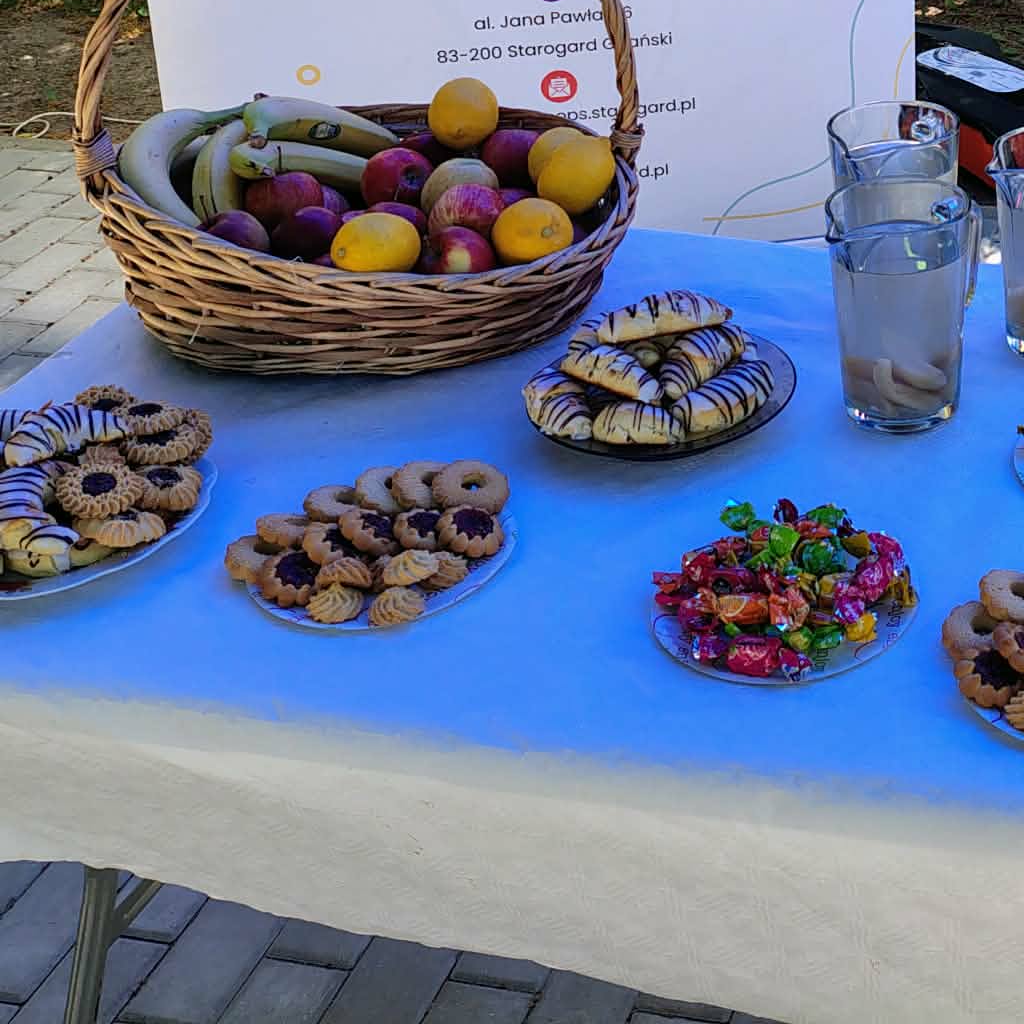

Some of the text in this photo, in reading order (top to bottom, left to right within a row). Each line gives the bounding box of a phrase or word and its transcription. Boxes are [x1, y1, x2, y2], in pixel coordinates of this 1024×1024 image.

[474, 15, 495, 31] al.
[500, 14, 545, 29] Jana
[551, 7, 603, 25] Pawła
[436, 31, 673, 64] 83-200 Starogard Gański
